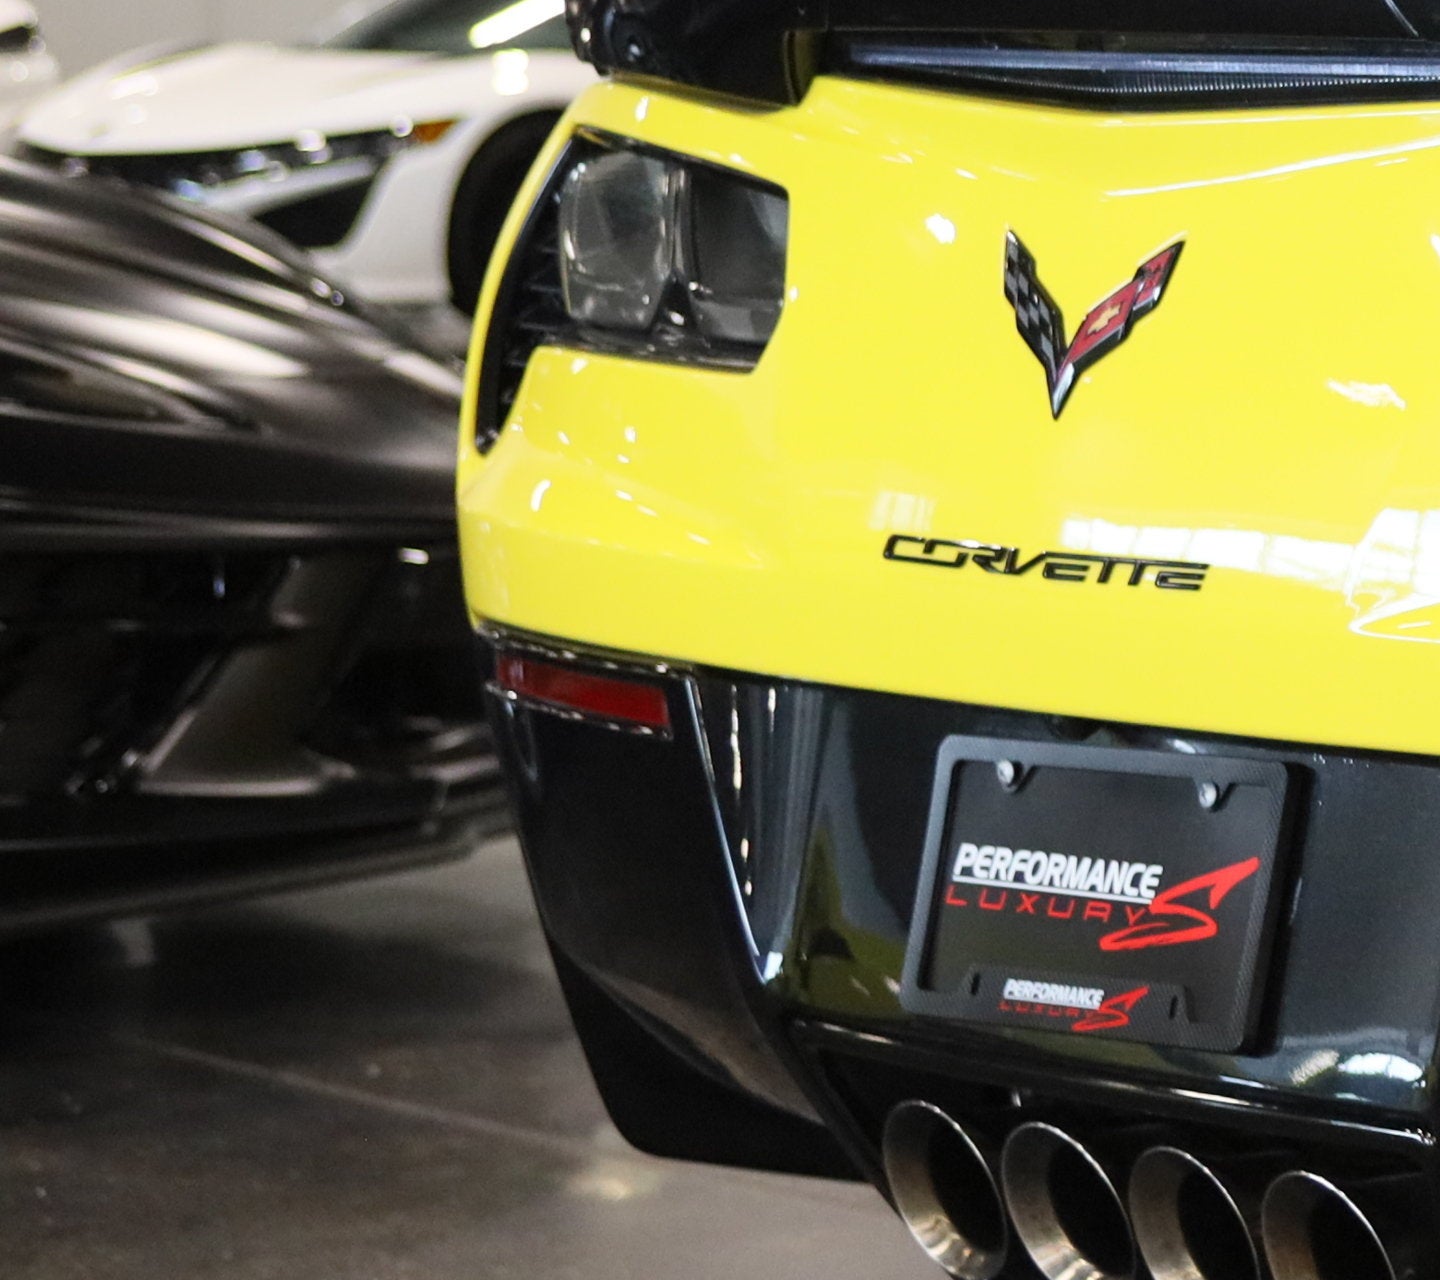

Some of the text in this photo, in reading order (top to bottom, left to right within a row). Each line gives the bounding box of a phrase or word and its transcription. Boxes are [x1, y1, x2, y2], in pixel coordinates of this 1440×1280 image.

[883, 534, 1210, 592] CORVETTE
[953, 842, 1163, 899] PERFORMANCE
[945, 885, 1147, 926] LUXURY
[1003, 978, 1105, 1009] PERFORMANCE
